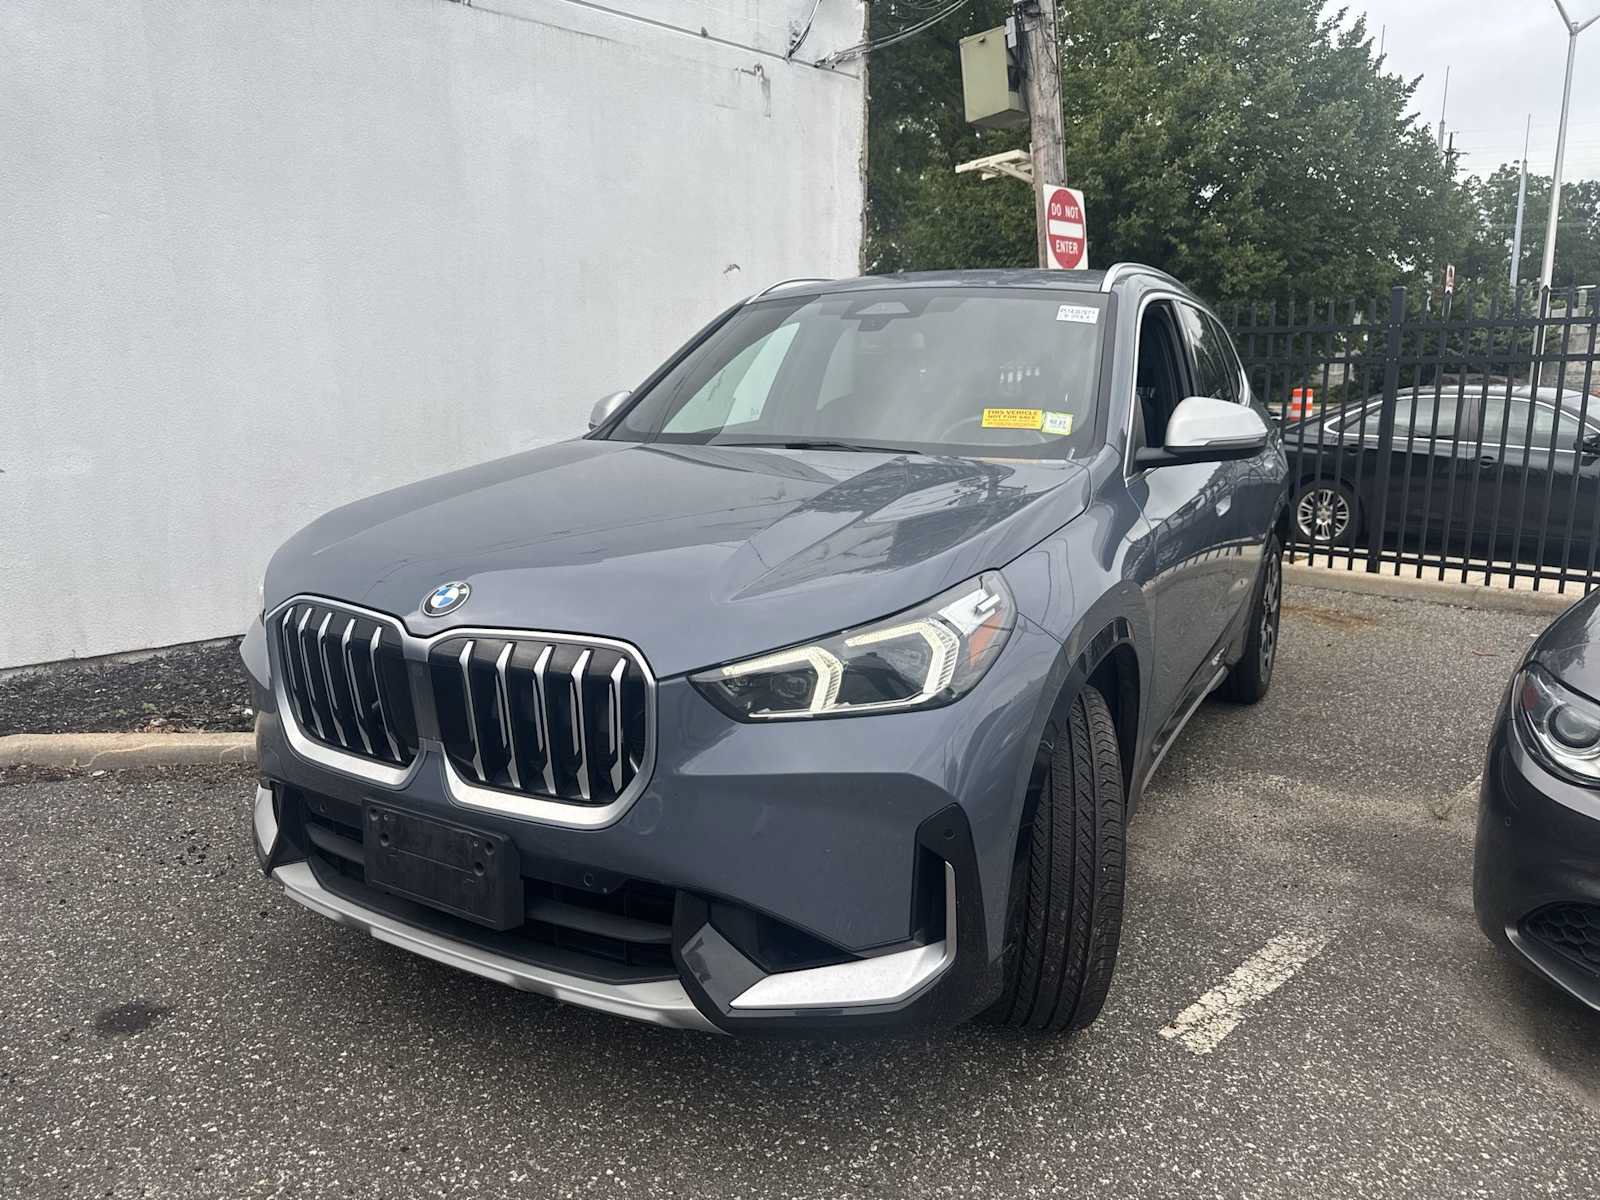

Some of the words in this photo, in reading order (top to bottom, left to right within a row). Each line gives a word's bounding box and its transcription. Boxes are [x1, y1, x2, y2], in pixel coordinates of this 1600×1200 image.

[1051, 203, 1062, 216] DO
[1065, 205, 1079, 219] NOT
[1055, 240, 1079, 255] ENTER
